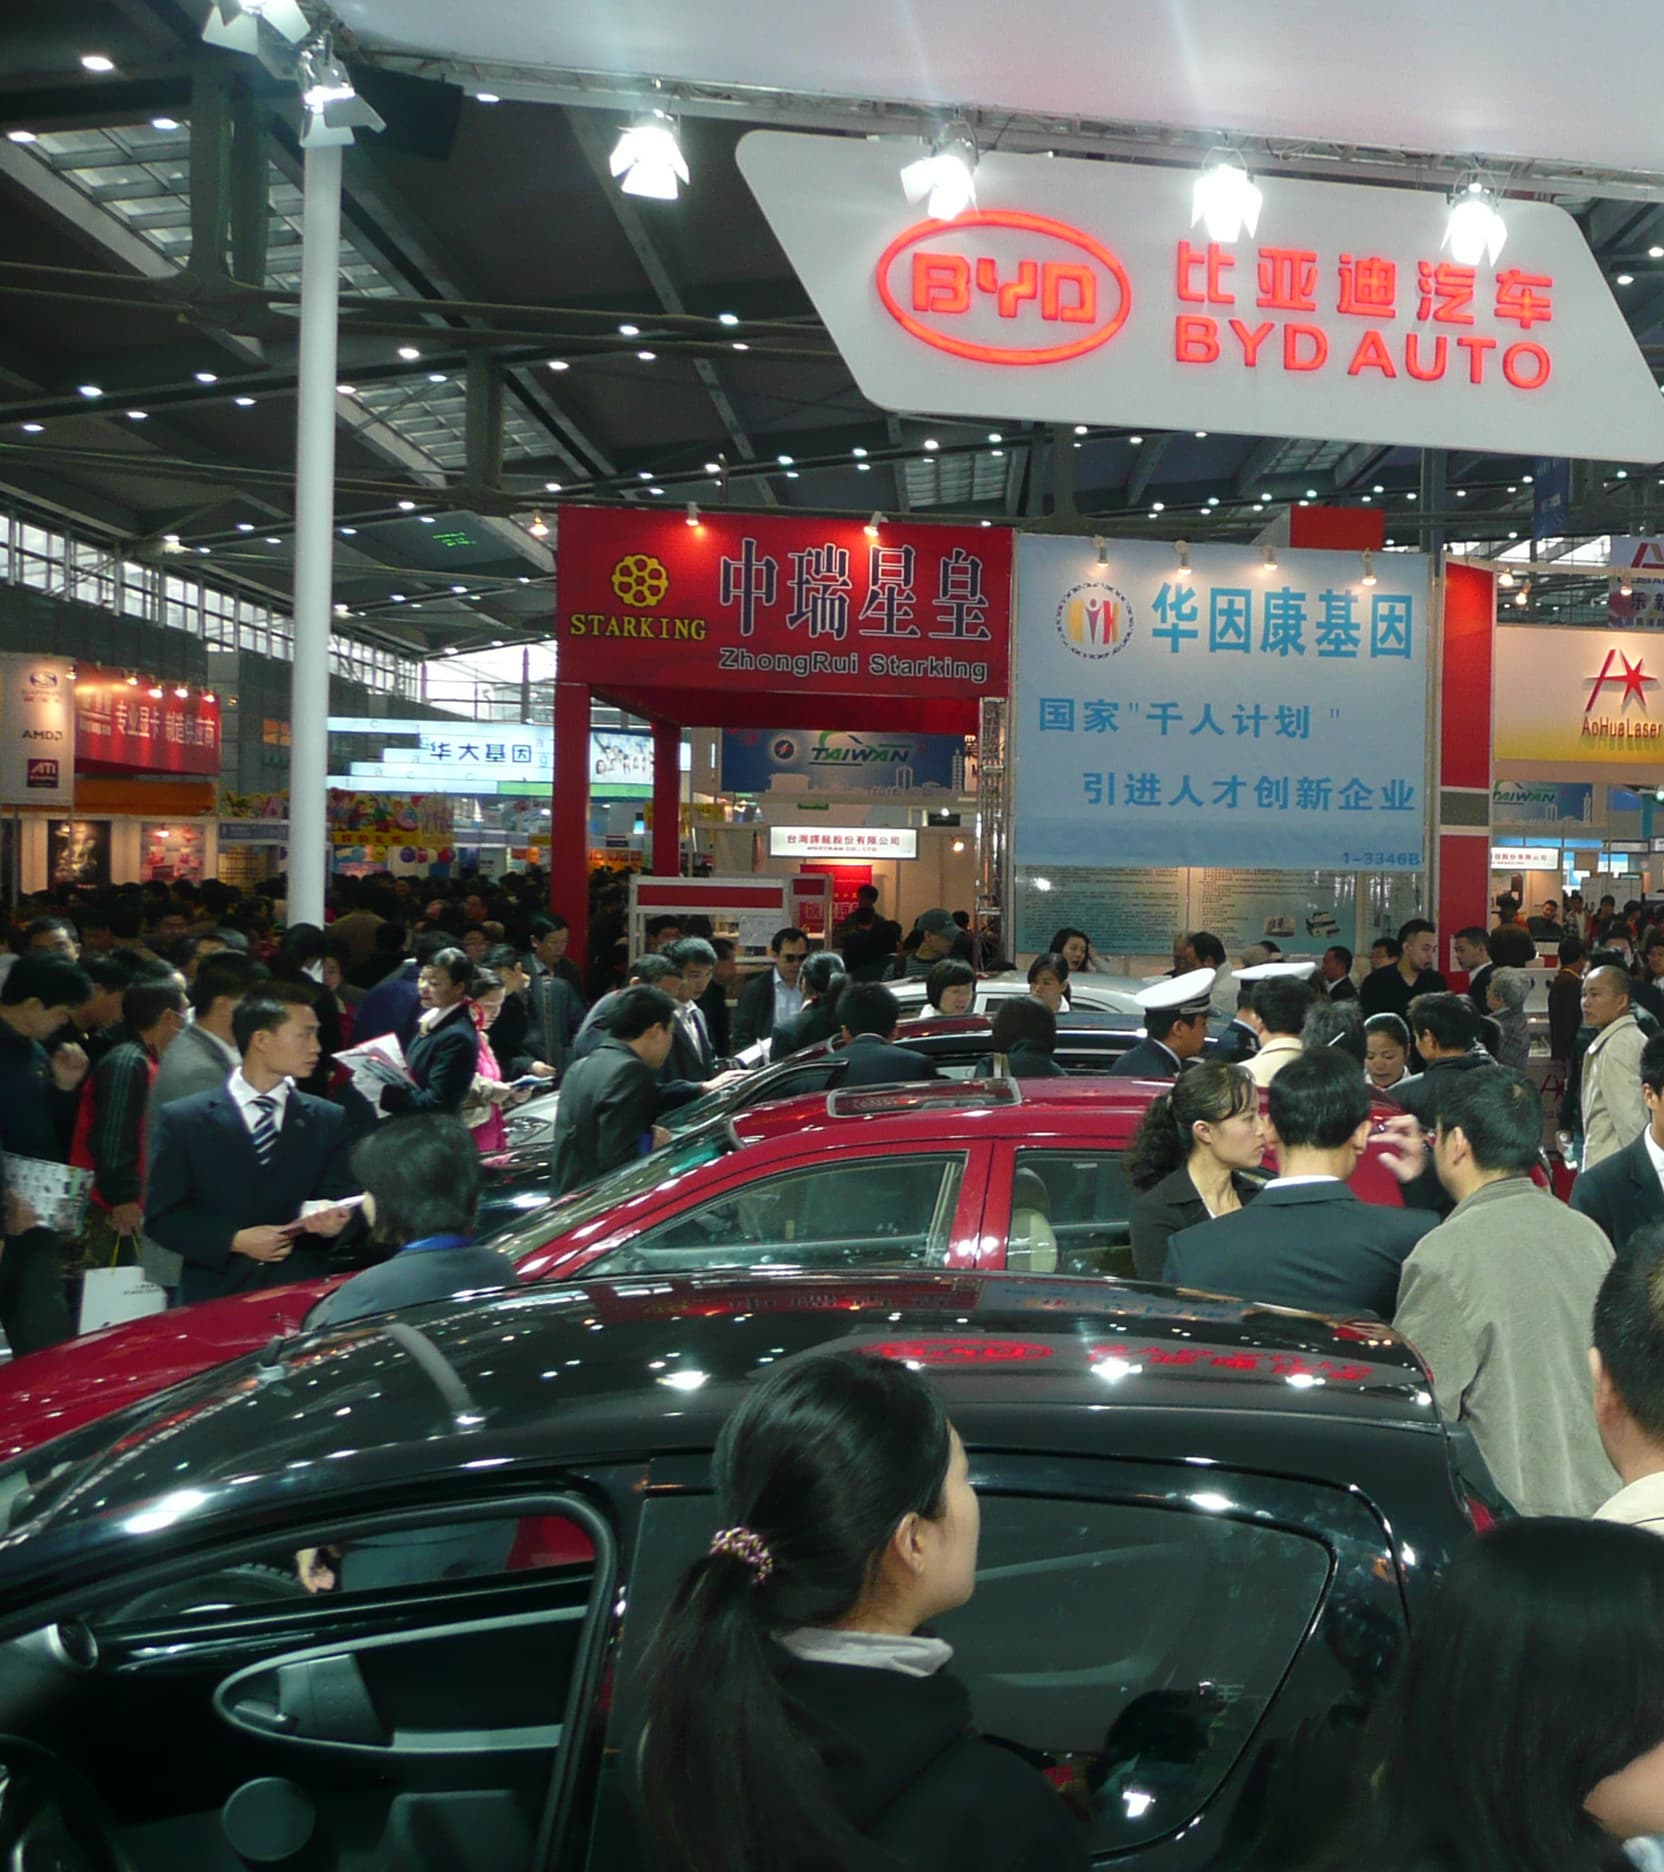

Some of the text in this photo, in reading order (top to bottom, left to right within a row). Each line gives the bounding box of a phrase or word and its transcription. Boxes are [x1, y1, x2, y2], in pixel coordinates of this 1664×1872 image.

[912, 251, 1097, 325] BYD
[1175, 240, 1553, 329] 比亚迪汽车
[1175, 314, 1552, 390] BYD AUTO
[719, 536, 992, 641] 中瑞星皇
[569, 614, 707, 641] STARKING
[1151, 582, 1414, 660] 华因康基因
[718, 647, 989, 684] ZhongRui Starking
[1581, 716, 1664, 739] AoHuaLaser
[430, 742, 532, 764] 华大基因
[811, 740, 911, 763] TAIWAN
[1083, 772, 1417, 812] 引进人才创新企业
